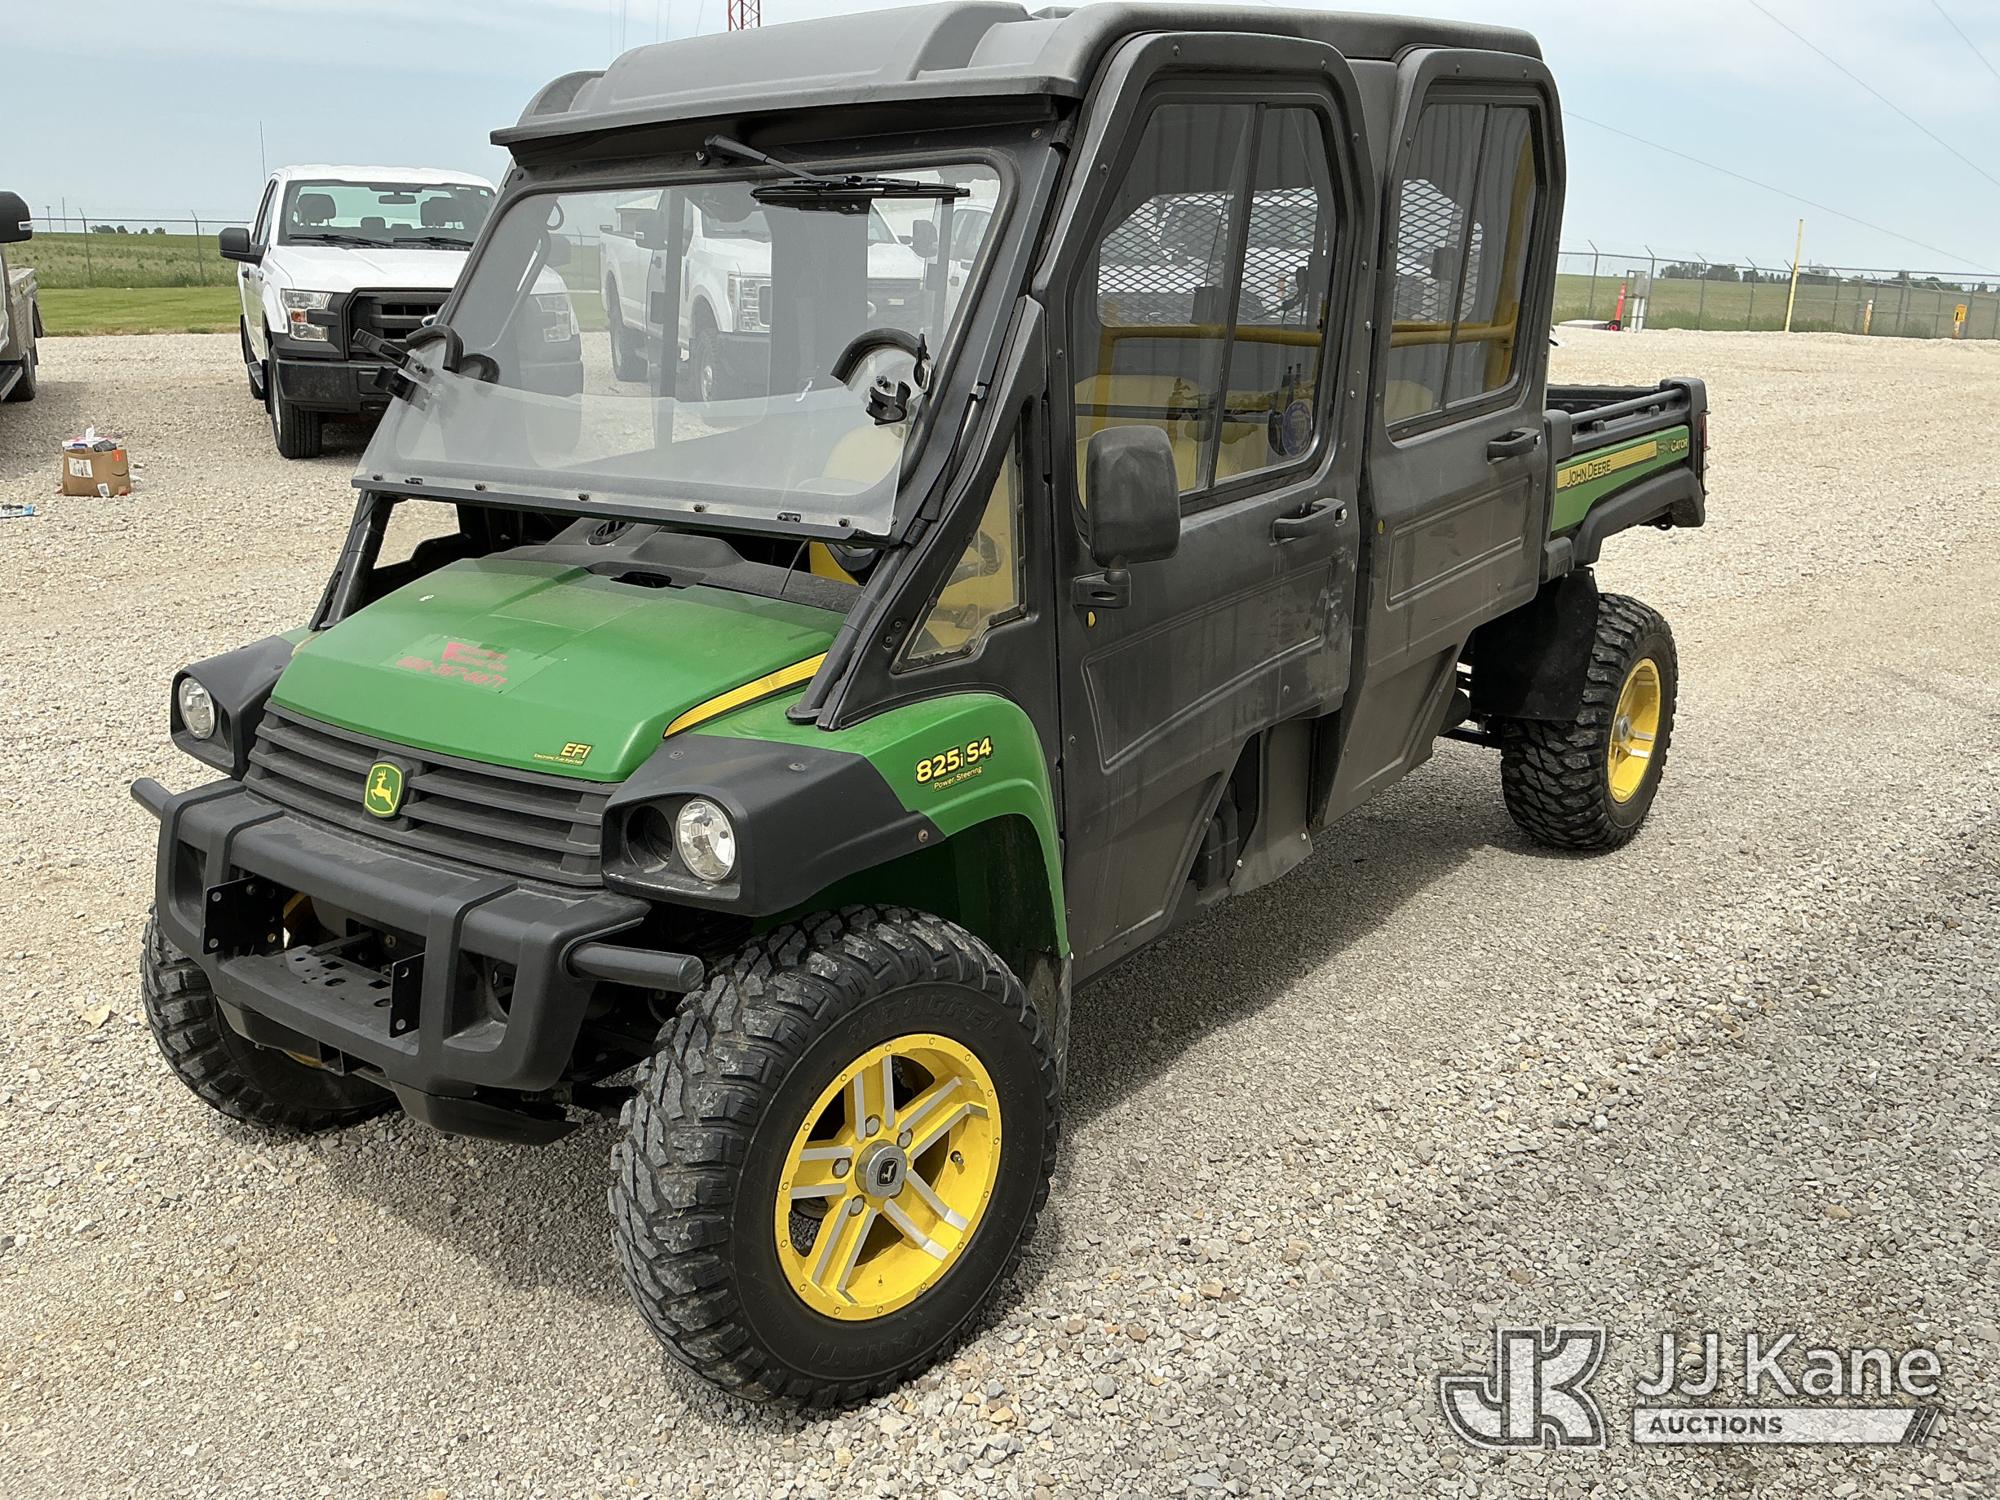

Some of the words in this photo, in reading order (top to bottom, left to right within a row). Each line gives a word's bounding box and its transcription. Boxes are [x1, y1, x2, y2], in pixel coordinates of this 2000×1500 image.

[1566, 464, 1587, 486] JOHN
[1587, 460, 1611, 480] DEERE
[561, 742, 592, 759] EFI
[916, 748, 963, 782] 825i
[966, 737, 992, 762] S4
